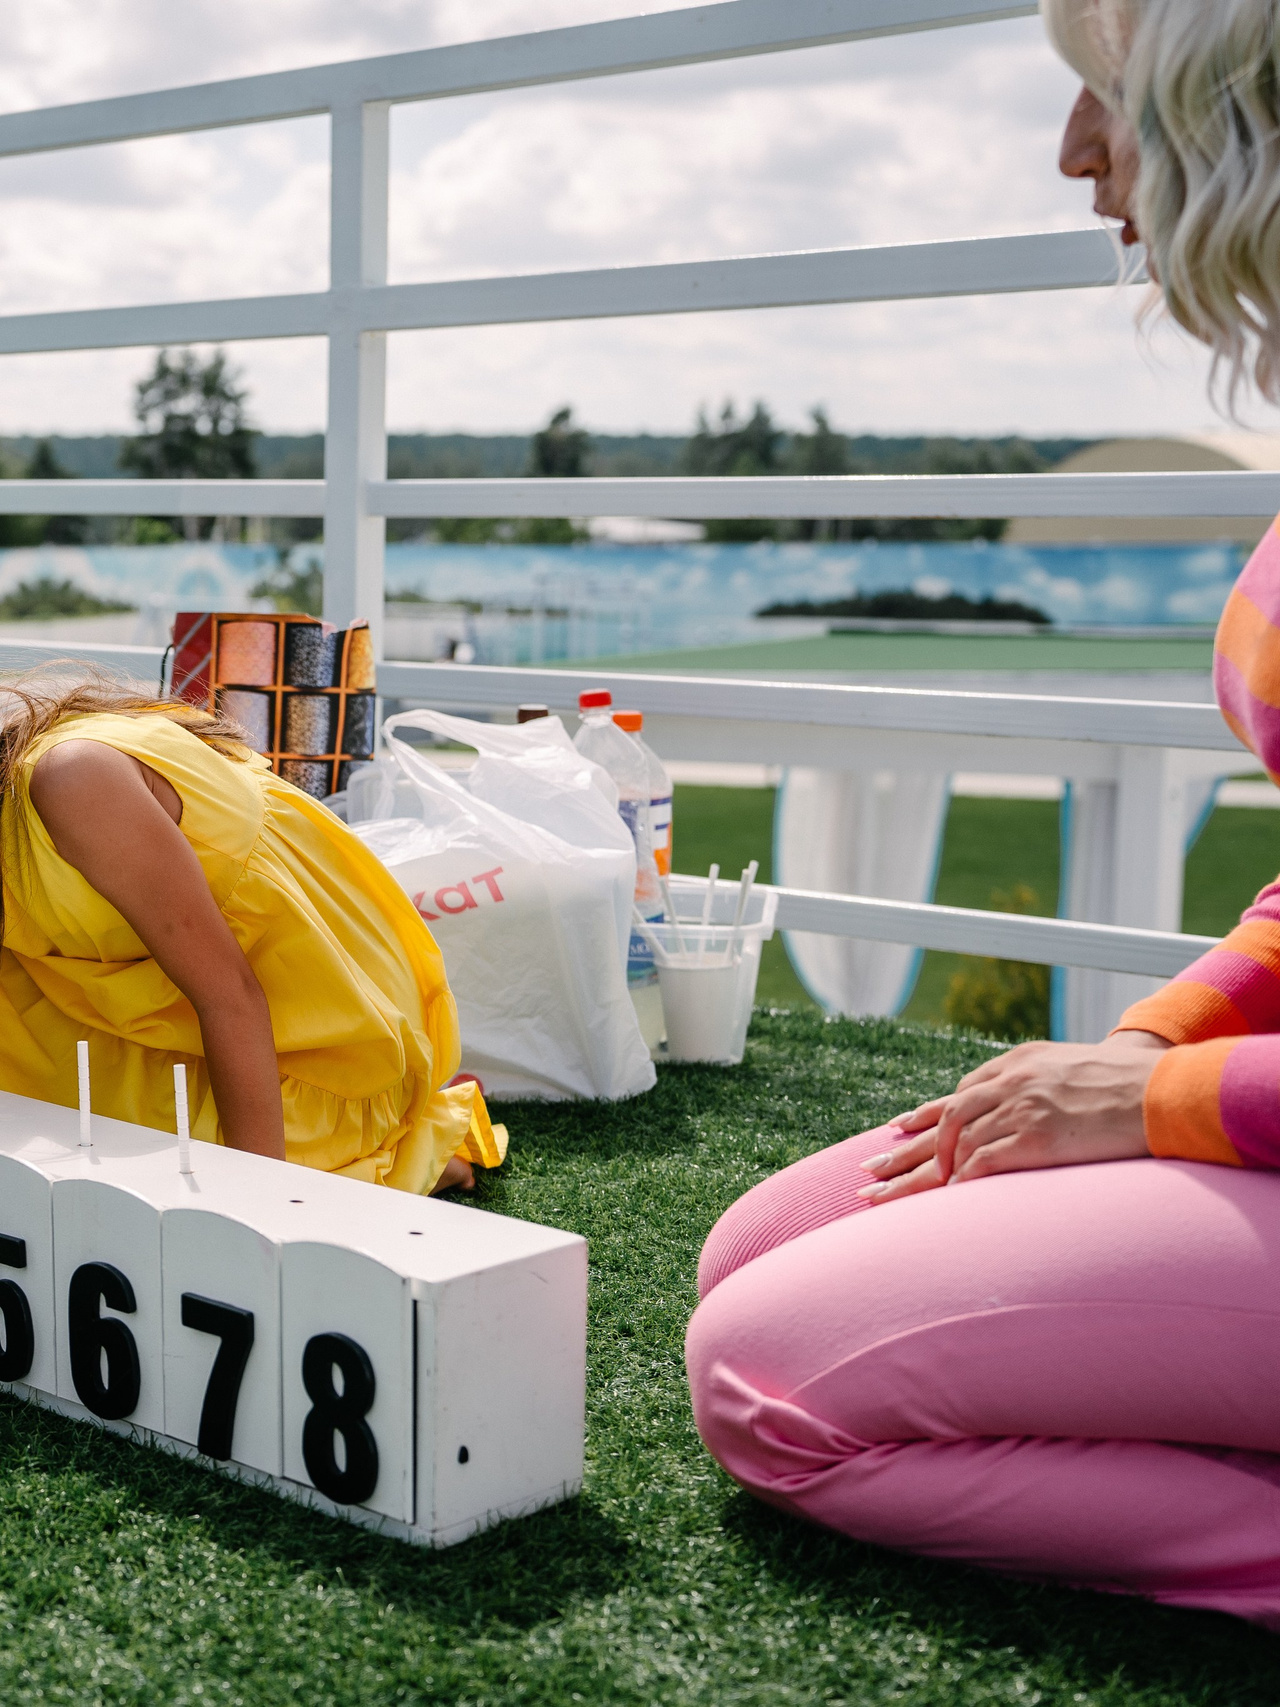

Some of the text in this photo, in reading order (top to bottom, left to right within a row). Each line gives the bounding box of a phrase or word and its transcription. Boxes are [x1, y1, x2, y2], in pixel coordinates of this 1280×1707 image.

[69, 1261, 141, 1420] 6
[181, 1292, 254, 1461] 7
[302, 1332, 376, 1505] 8
